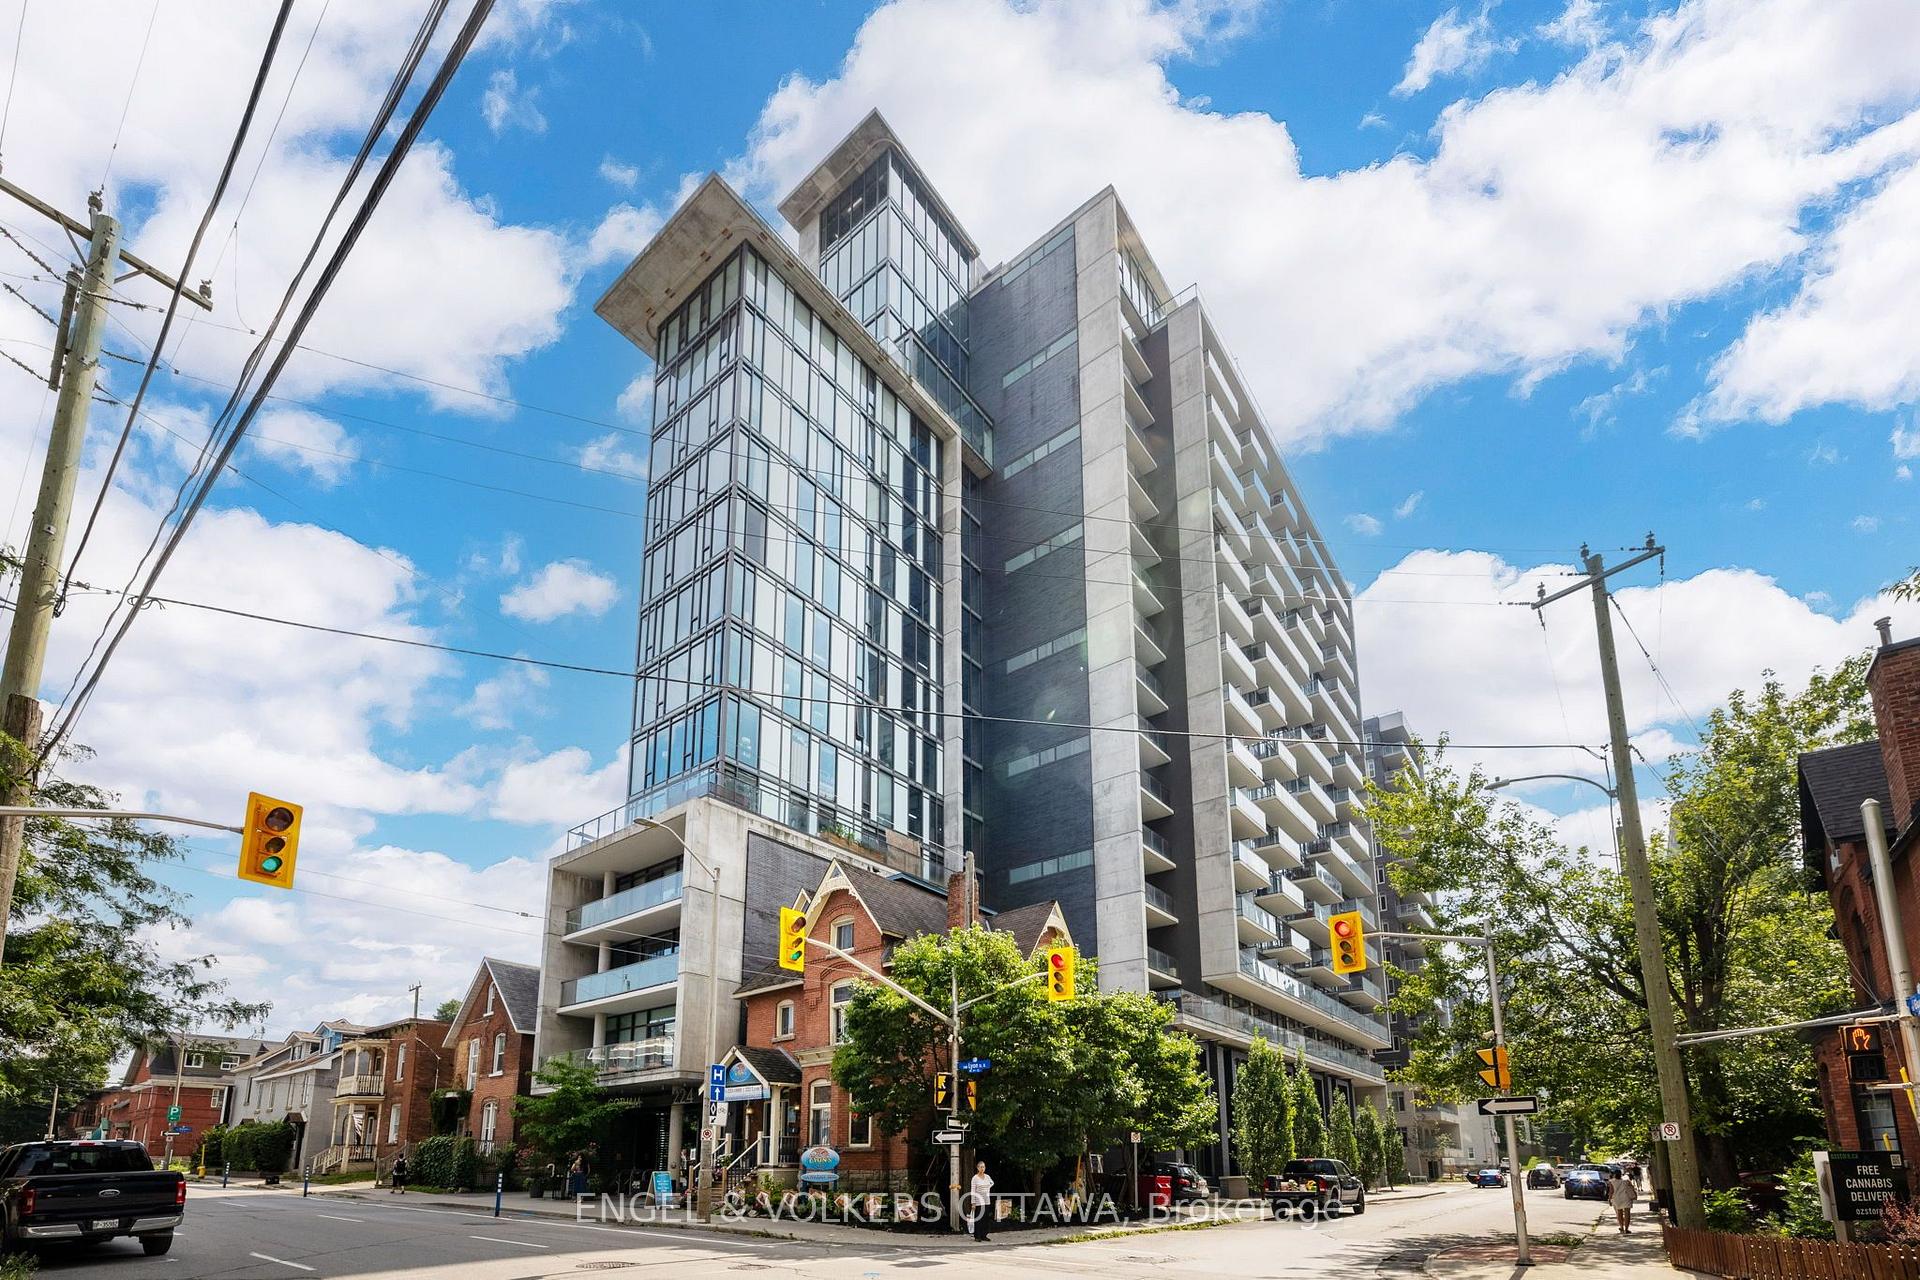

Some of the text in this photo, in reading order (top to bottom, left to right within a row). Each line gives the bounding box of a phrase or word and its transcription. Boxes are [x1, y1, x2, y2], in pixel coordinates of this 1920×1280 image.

[967, 1062, 979, 1070] Lyon
[713, 1069, 723, 1081] H
[672, 1087, 694, 1105] 224
[170, 1107, 179, 1116] P
[1857, 1165, 1880, 1175] FREE
[1845, 1178, 1893, 1188] CANNABIS
[1850, 1191, 1895, 1201] DELIVERY
